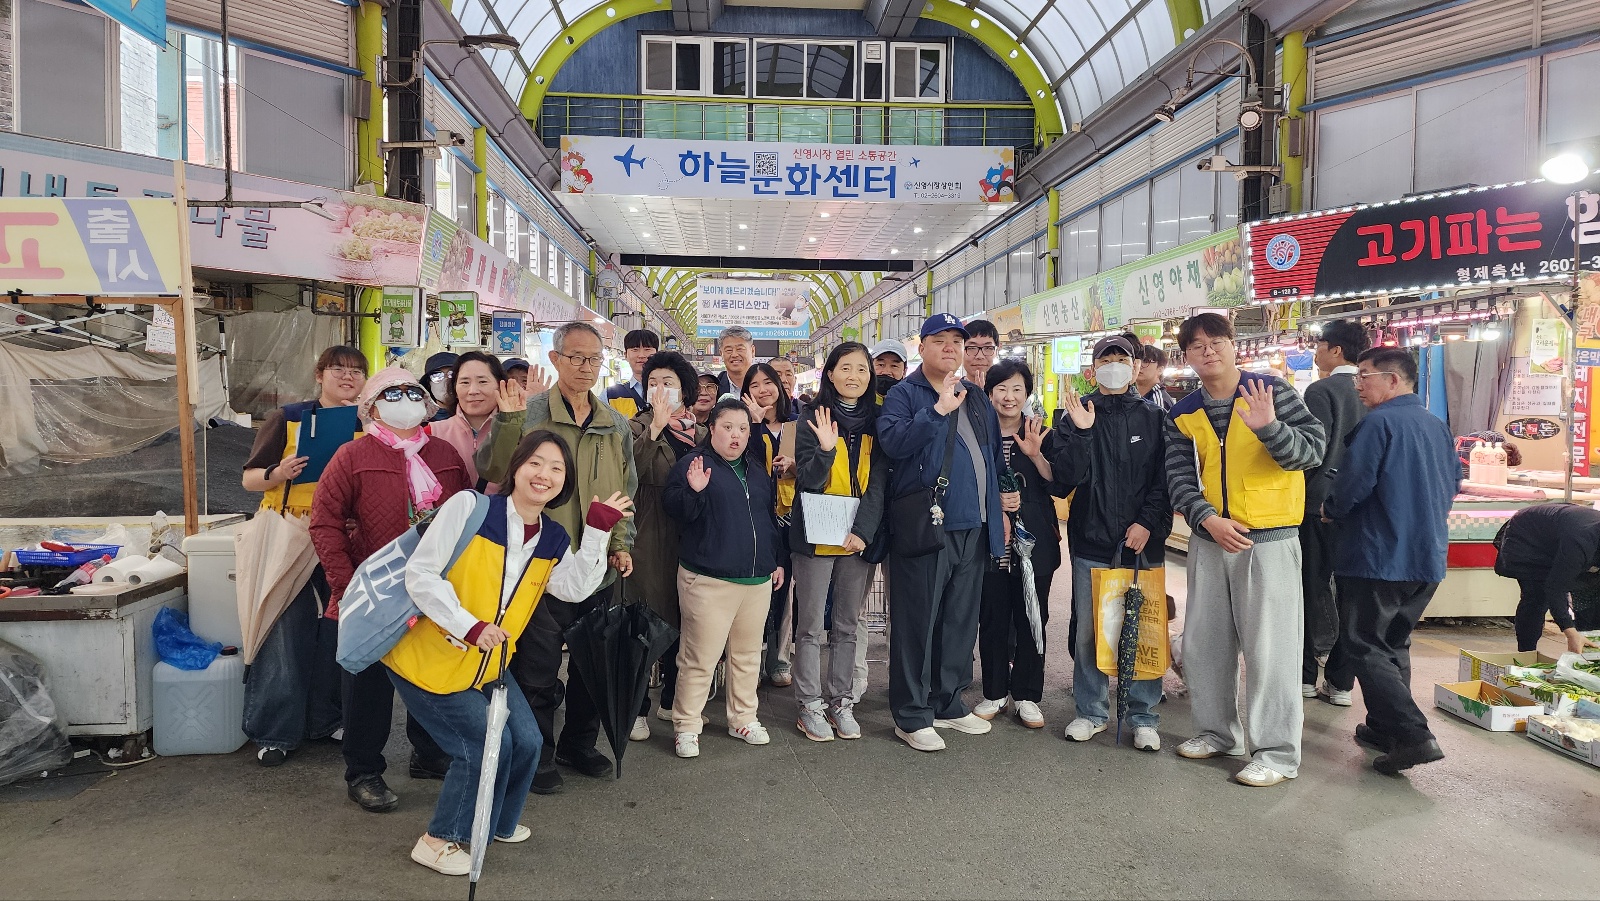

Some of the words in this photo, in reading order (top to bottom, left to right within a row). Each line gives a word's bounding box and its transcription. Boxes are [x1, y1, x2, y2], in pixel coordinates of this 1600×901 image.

[792, 148, 832, 160] 신영시장
[836, 149, 854, 160] 열린
[858, 150, 897, 162] 소통공간
[679, 150, 750, 184] 하늘
[913, 181, 962, 190] 신영시장상인회
[1356, 206, 1543, 267] 고기파는
[1456, 262, 1526, 282] 형제축산
[1137, 258, 1202, 306] 신영야채
[712, 299, 770, 311] 서울리더스안과
[1042, 295, 1080, 327] 신영농산
[943, 313, 956, 325] LA
[1142, 599, 1161, 608] OVE
[1139, 607, 1161, 617] LEAN
[1136, 644, 1160, 660] AVE
